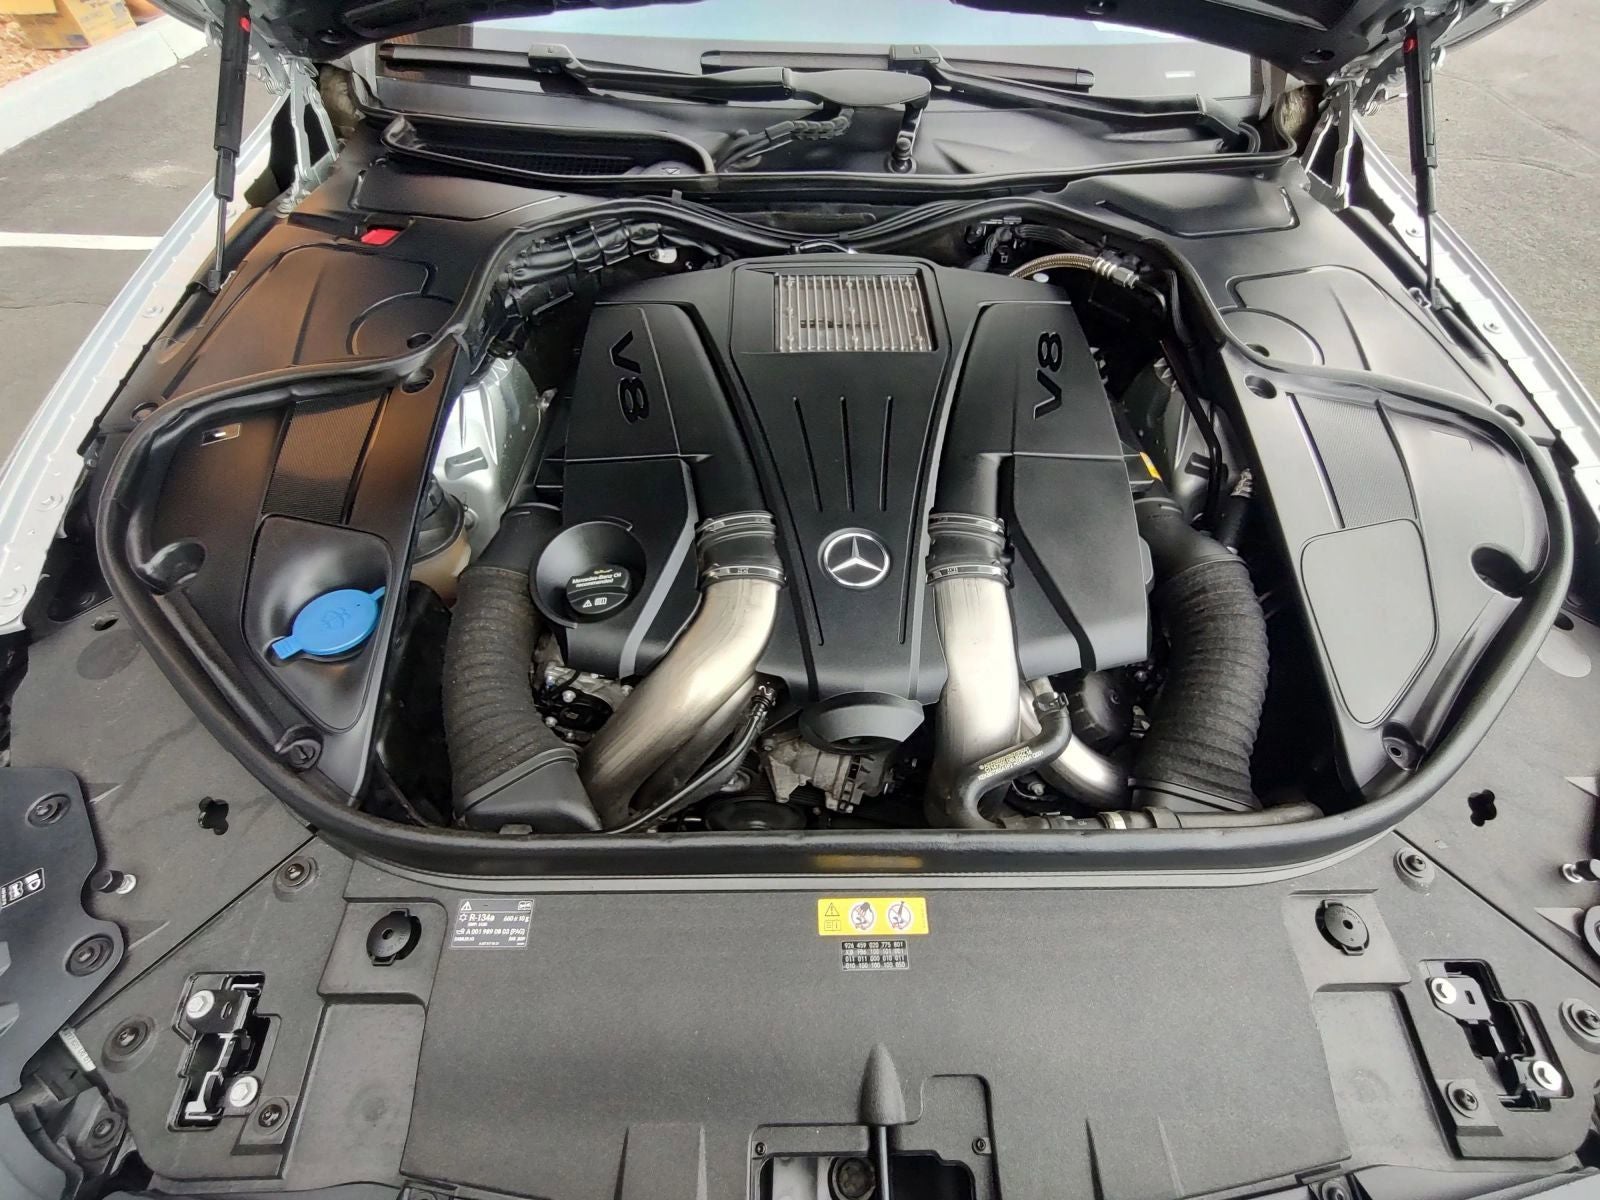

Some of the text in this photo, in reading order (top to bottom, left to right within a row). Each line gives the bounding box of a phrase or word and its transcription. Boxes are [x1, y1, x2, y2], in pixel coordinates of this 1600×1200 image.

[609, 329, 649, 425] V8
[1033, 331, 1062, 420] V8
[468, 914, 495, 922] R-134a
